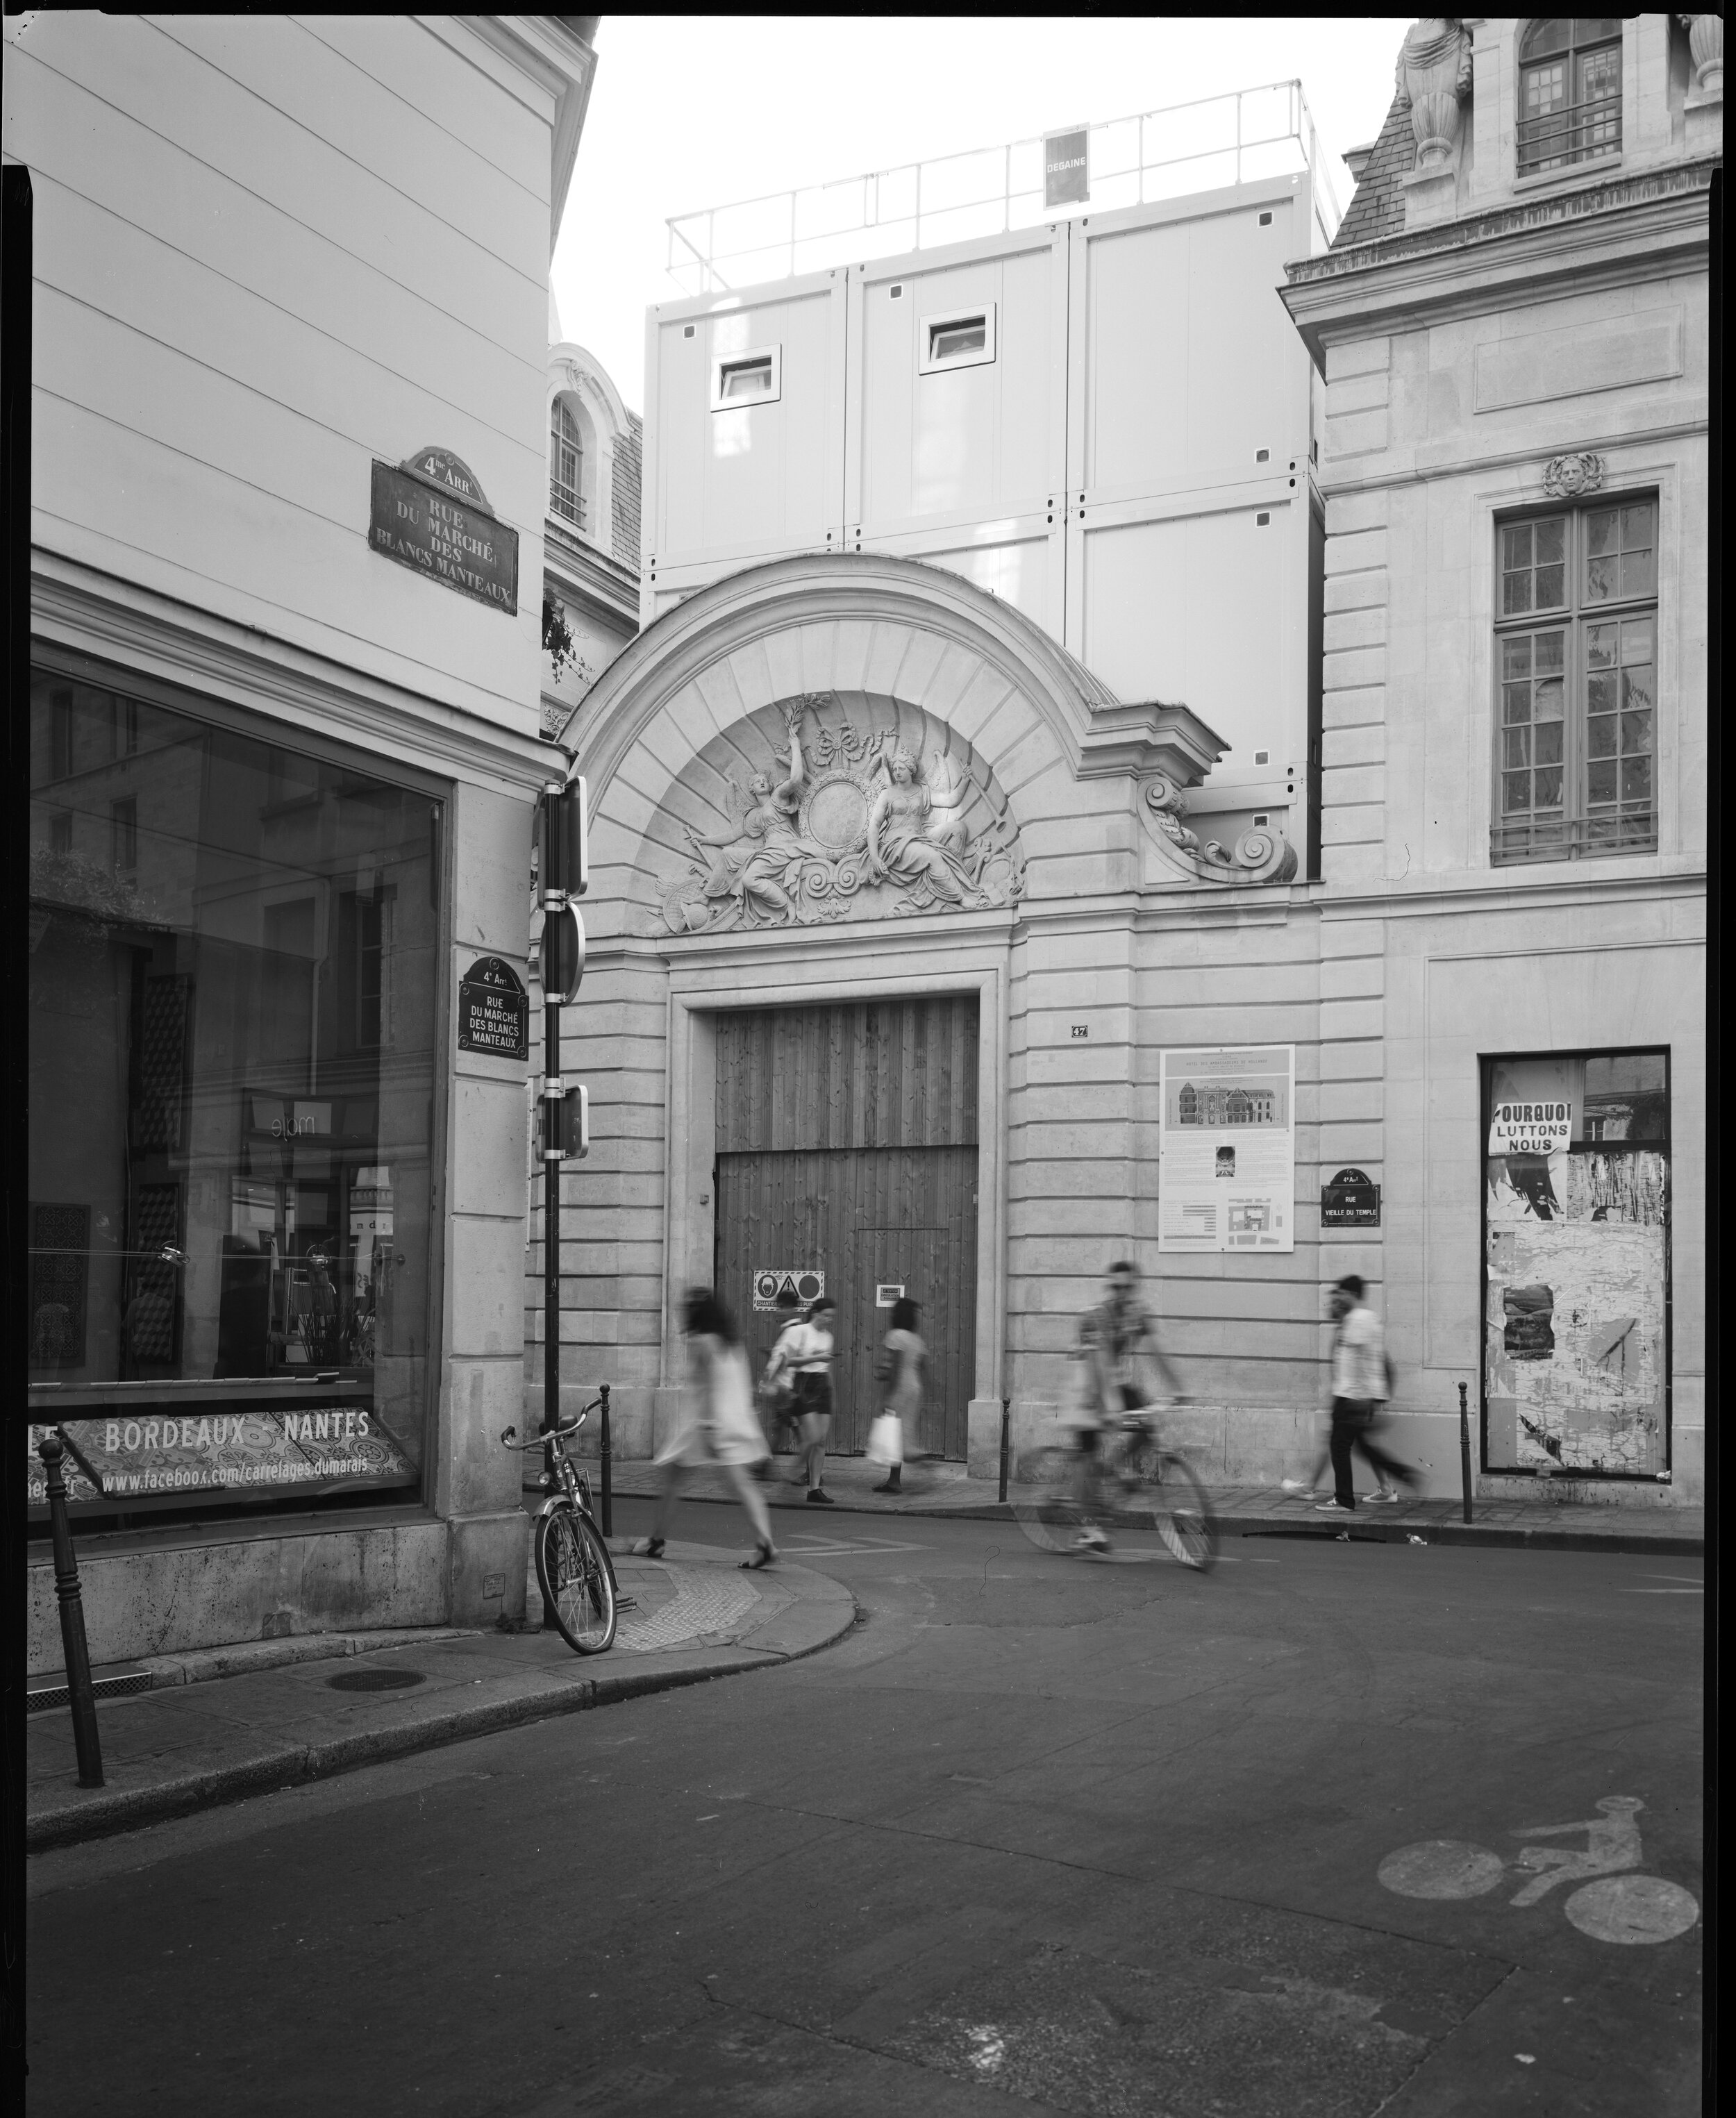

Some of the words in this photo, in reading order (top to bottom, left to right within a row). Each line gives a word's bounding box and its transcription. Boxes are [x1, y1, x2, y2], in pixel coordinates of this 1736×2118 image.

[1047, 156, 1086, 173] DEGAINE
[429, 499, 463, 528] RUE
[397, 501, 419, 524] DU
[428, 517, 492, 562] MARCHÉ
[431, 536, 462, 562] DES
[376, 527, 432, 567] BLANCS
[437, 557, 510, 603] MANTEAUX
[487, 996, 503, 1009] RUE
[471, 1005, 483, 1017] DU
[484, 1008, 518, 1024] MARCHÉ
[469, 1017, 486, 1031] DES
[488, 1022, 519, 1037] BLANCS
[1074, 1027, 1086, 1035] 47
[472, 1031, 516, 1049] MANTEAUX
[1497, 1125, 1568, 1137] LUTTONS
[1509, 1140, 1552, 1151] NOUS
[106, 1418, 244, 1452] BORDEAUX
[285, 1412, 369, 1441] NANTES
